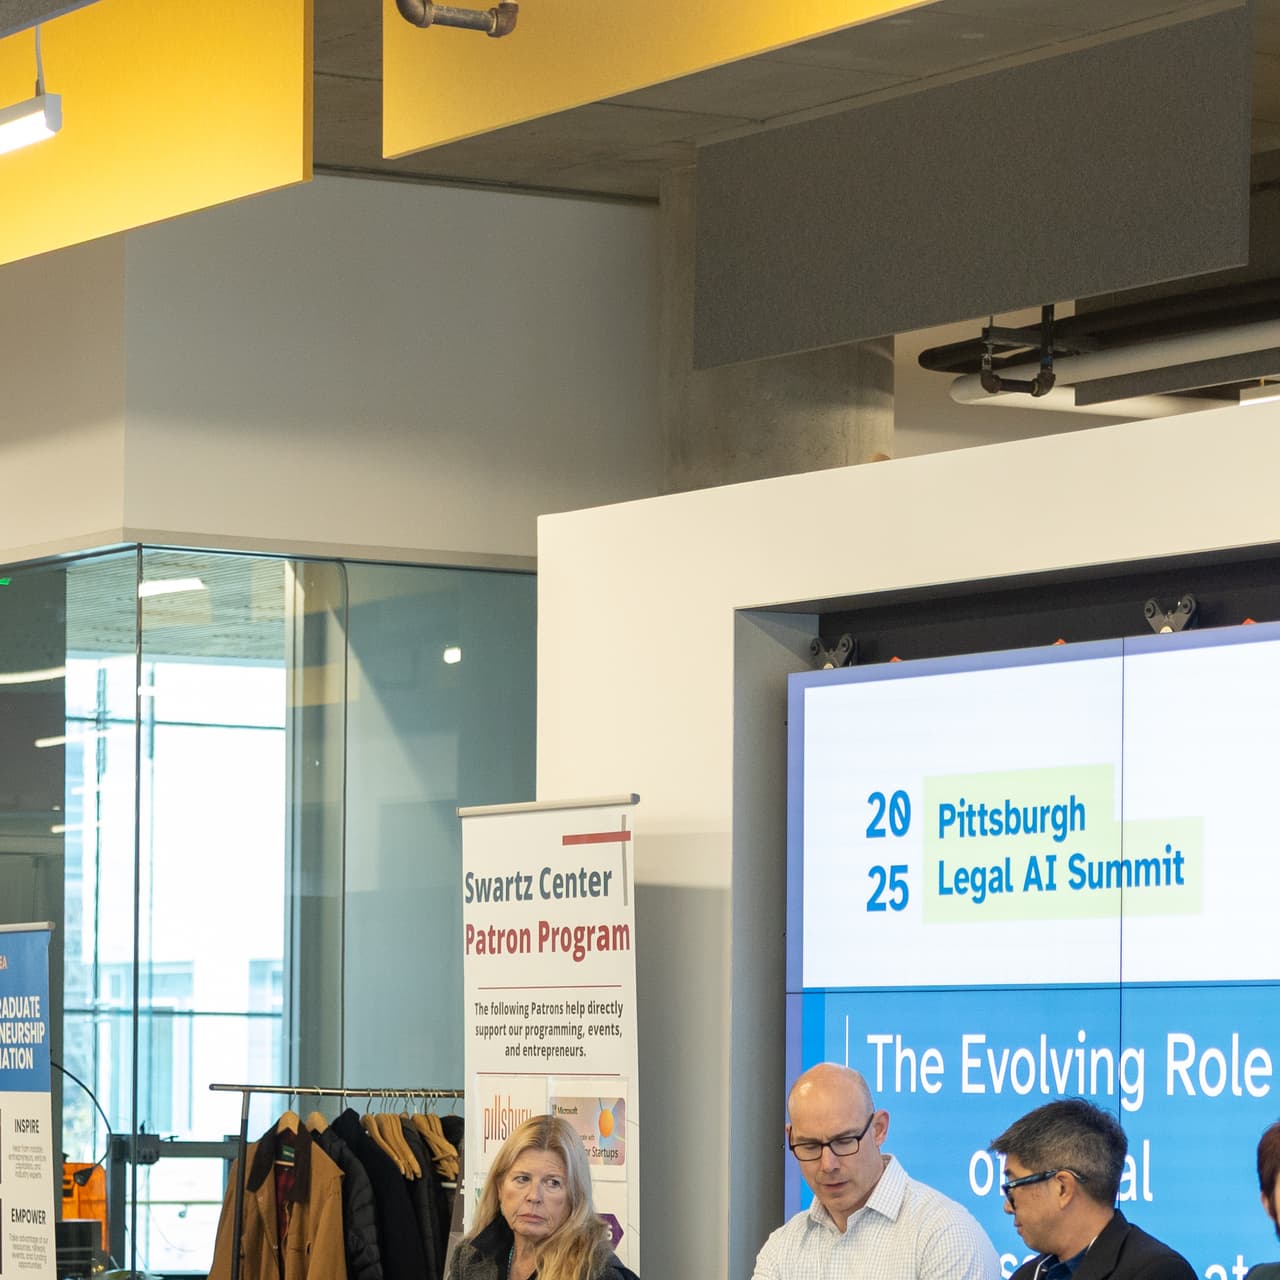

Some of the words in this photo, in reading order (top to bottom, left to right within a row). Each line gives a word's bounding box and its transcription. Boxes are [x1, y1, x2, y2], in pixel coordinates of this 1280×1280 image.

[865, 789, 912, 838] 20
[938, 794, 1086, 843] Pittsburgh
[465, 871, 534, 904] Swartz
[539, 867, 613, 900] Center
[866, 864, 910, 913] 25
[938, 857, 1014, 905] Legal
[1023, 854, 1057, 892] AI
[1067, 843, 1185, 890] Summit
[466, 923, 531, 956] Patron
[538, 920, 630, 963] Program
[474, 1002, 488, 1015] The
[490, 1001, 529, 1018] following
[531, 1001, 563, 1015] Patrons
[566, 1001, 585, 1018] help
[587, 1000, 623, 1018] directly
[475, 1024, 507, 1040] support
[508, 1024, 523, 1036] our
[525, 1022, 585, 1039] programming,
[588, 1023, 623, 1038] events,
[505, 1043, 521, 1057] and
[523, 1044, 587, 1060] entrepreneurs.
[866, 1033, 945, 1095] The
[960, 1029, 1145, 1112] Evolving
[1166, 1032, 1273, 1098] Role
[14, 1118, 40, 1134] INSPIRE
[592, 1146, 619, 1160] Startups
[11, 1207, 47, 1225] EMPOWER
